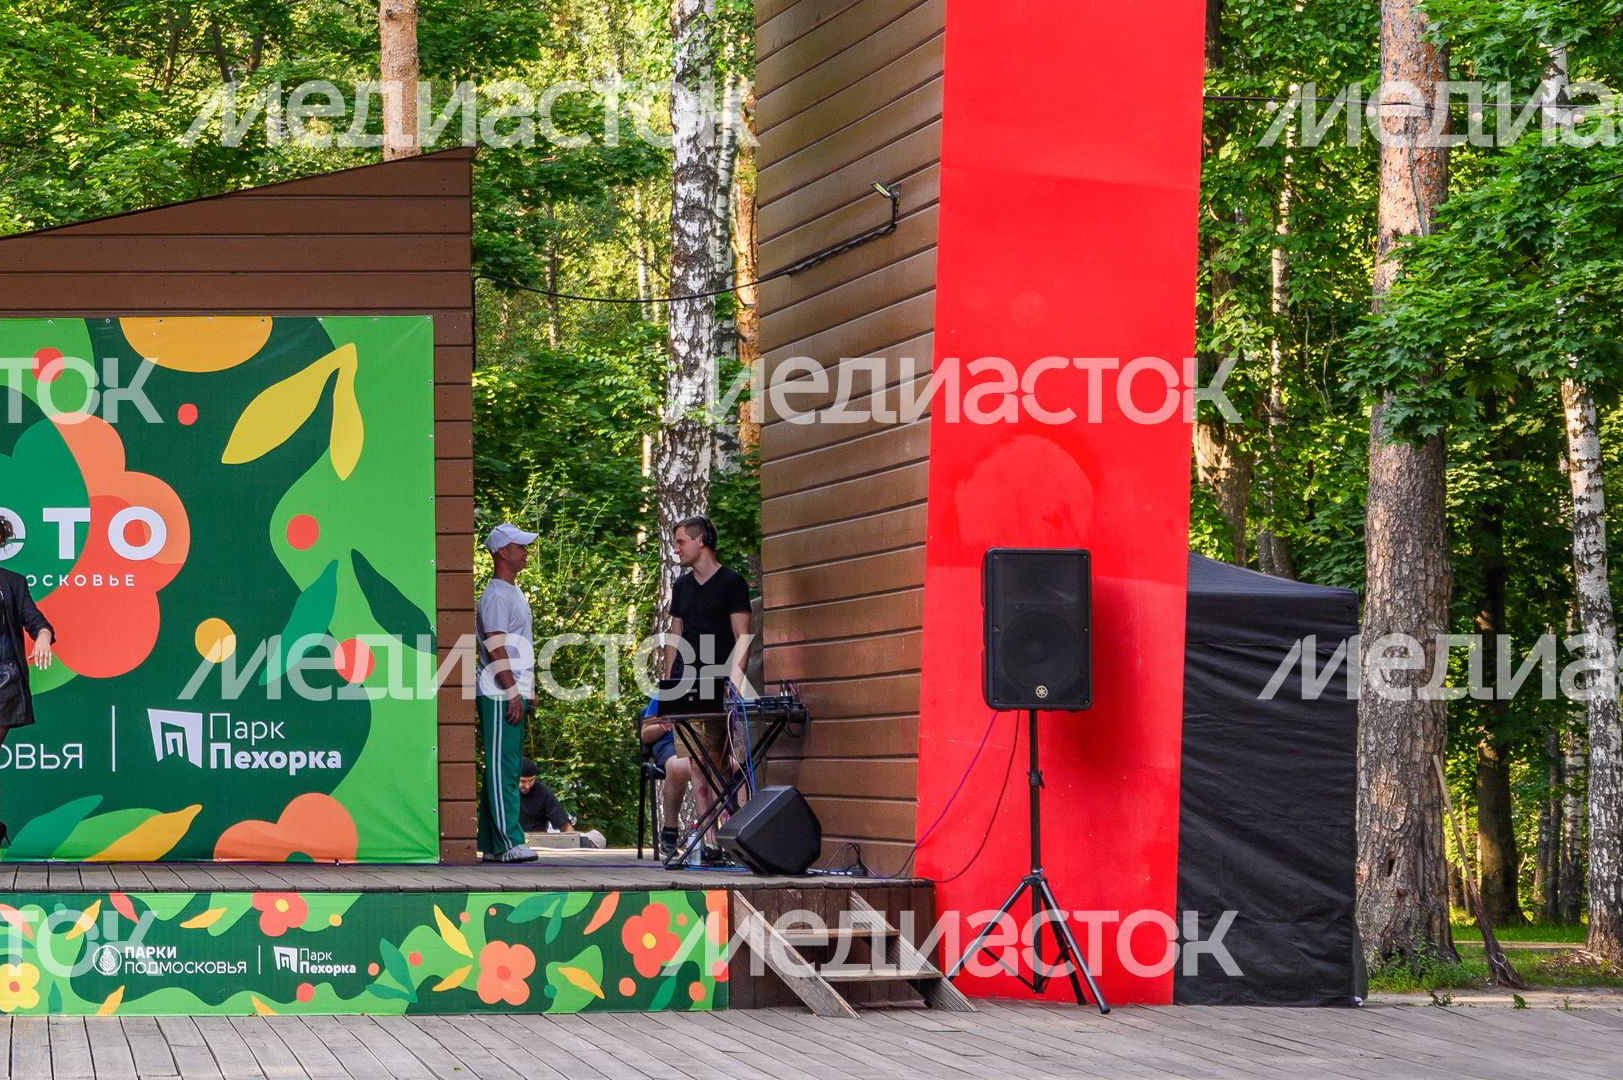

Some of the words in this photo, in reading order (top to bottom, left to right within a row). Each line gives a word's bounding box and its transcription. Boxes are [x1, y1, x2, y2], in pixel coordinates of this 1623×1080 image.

[26, 573, 136, 588] ОСКОВЬЕ
[209, 712, 286, 746] Парк
[209, 742, 343, 776] Пехорка
[124, 946, 177, 959] ПАРКИ
[299, 948, 333, 962] Парк
[124, 961, 247, 975] ПОДМОСКОВЬЯ
[299, 961, 357, 977] Пехорка
